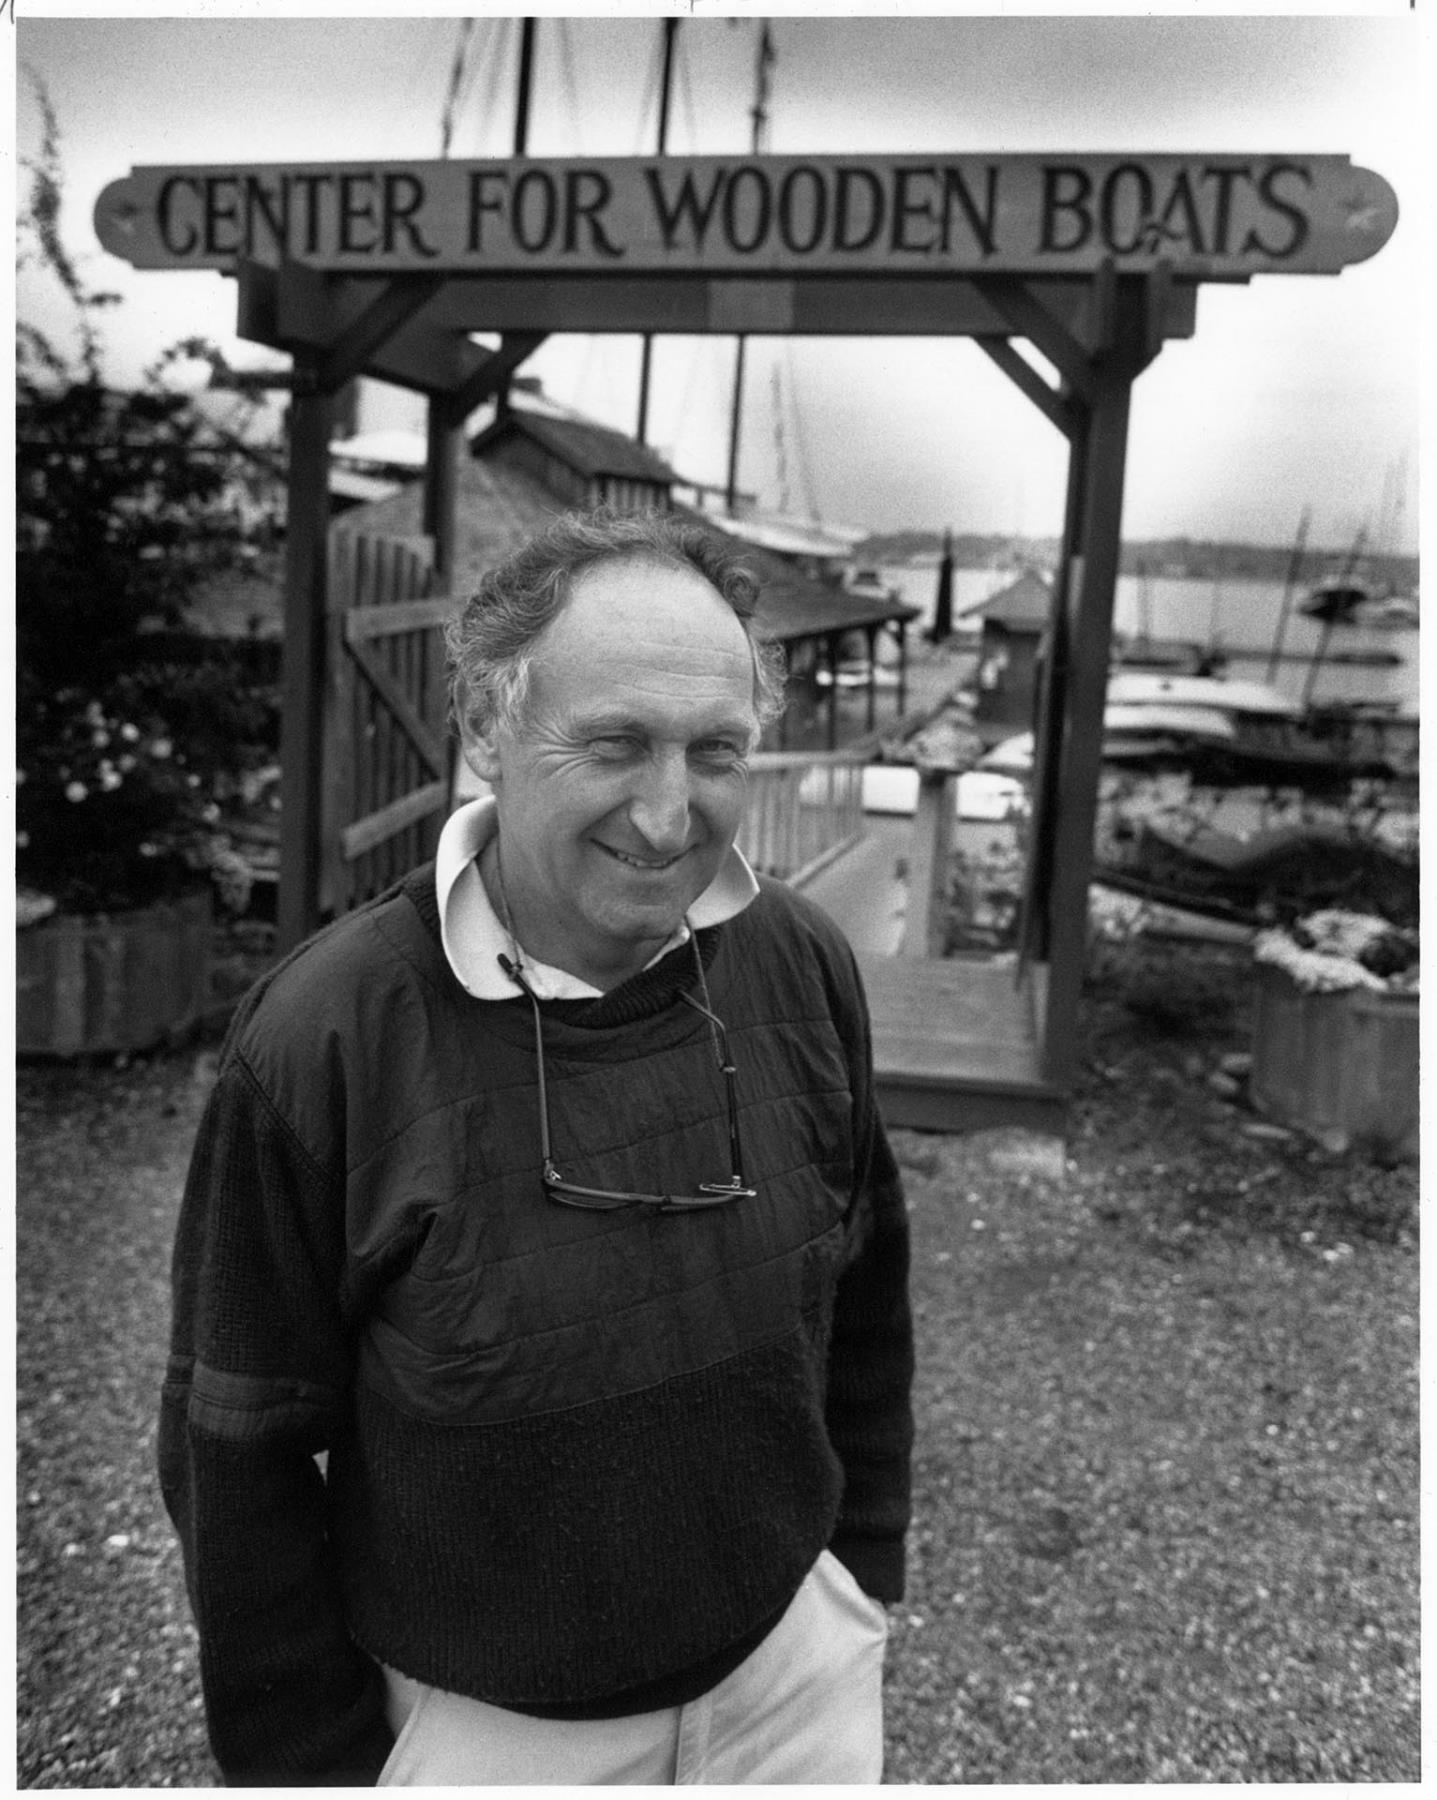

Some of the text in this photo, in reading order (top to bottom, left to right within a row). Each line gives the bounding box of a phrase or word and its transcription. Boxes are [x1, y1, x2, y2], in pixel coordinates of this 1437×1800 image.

[156, 163, 1313, 260] CENTER FOR WOODEN BOATS
